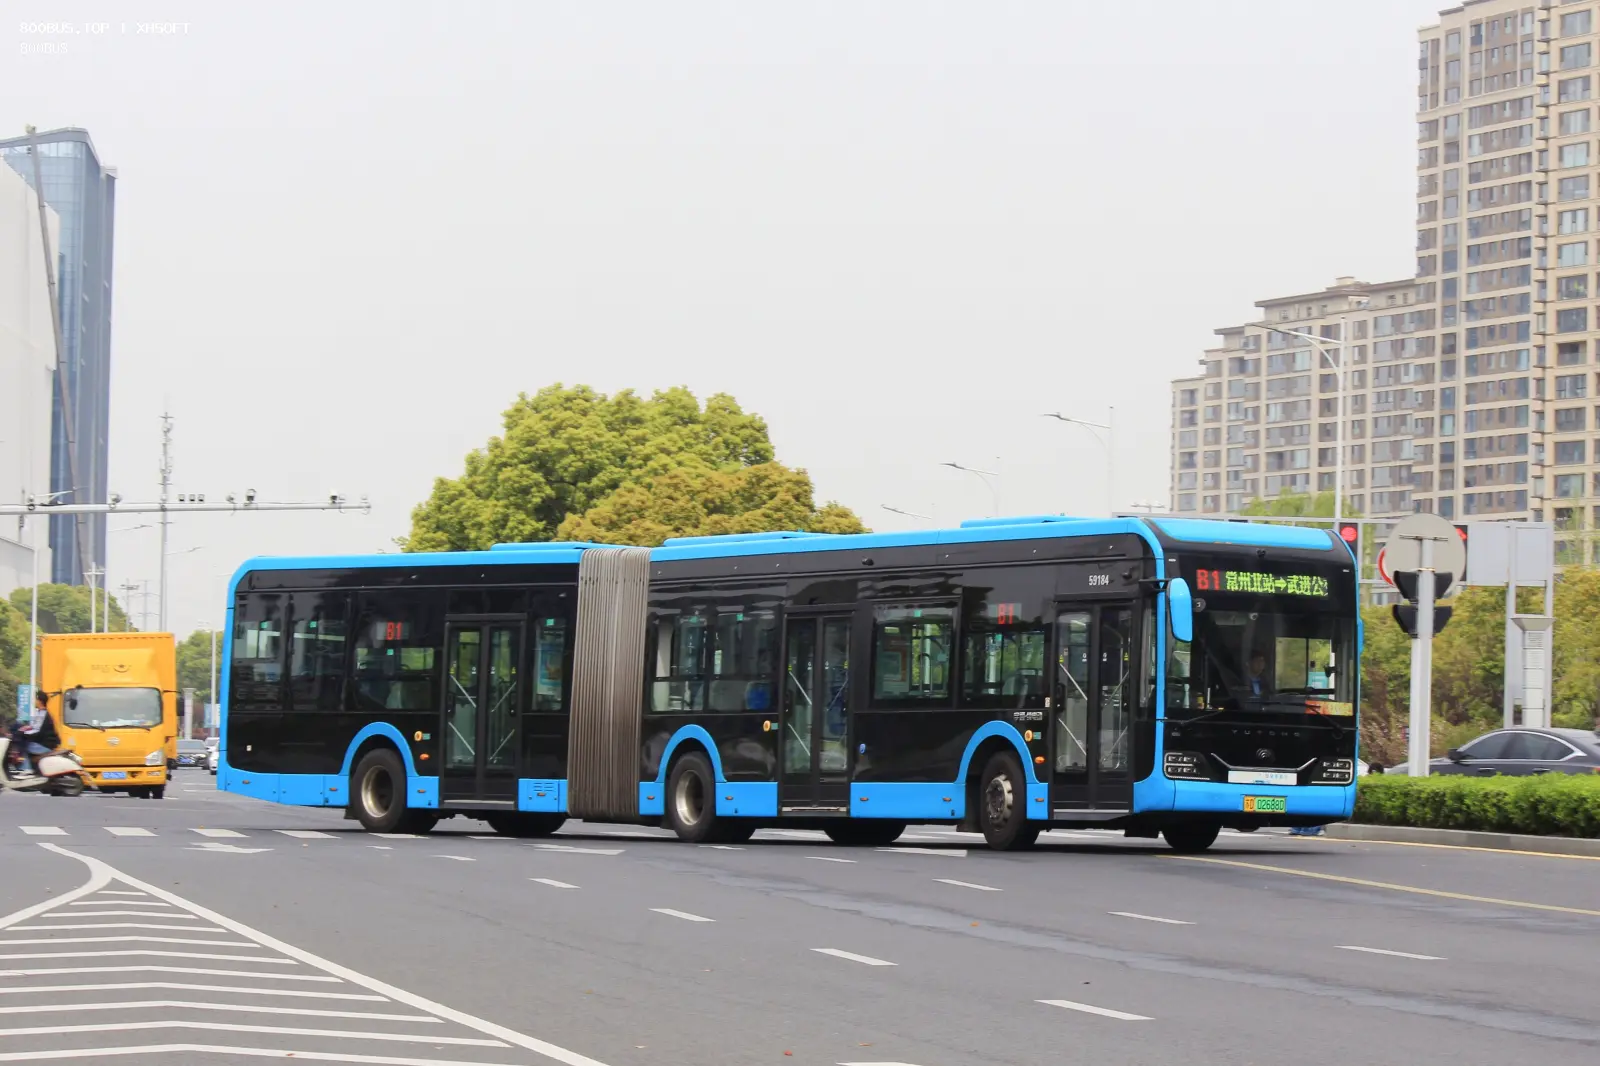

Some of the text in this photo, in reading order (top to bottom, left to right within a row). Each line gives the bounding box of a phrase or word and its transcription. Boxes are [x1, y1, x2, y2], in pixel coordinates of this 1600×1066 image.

[1088, 574, 1109, 586] 59184
[1196, 569, 1220, 591] B1
[1225, 571, 1275, 593] 常州北站
[386, 621, 402, 640] B1
